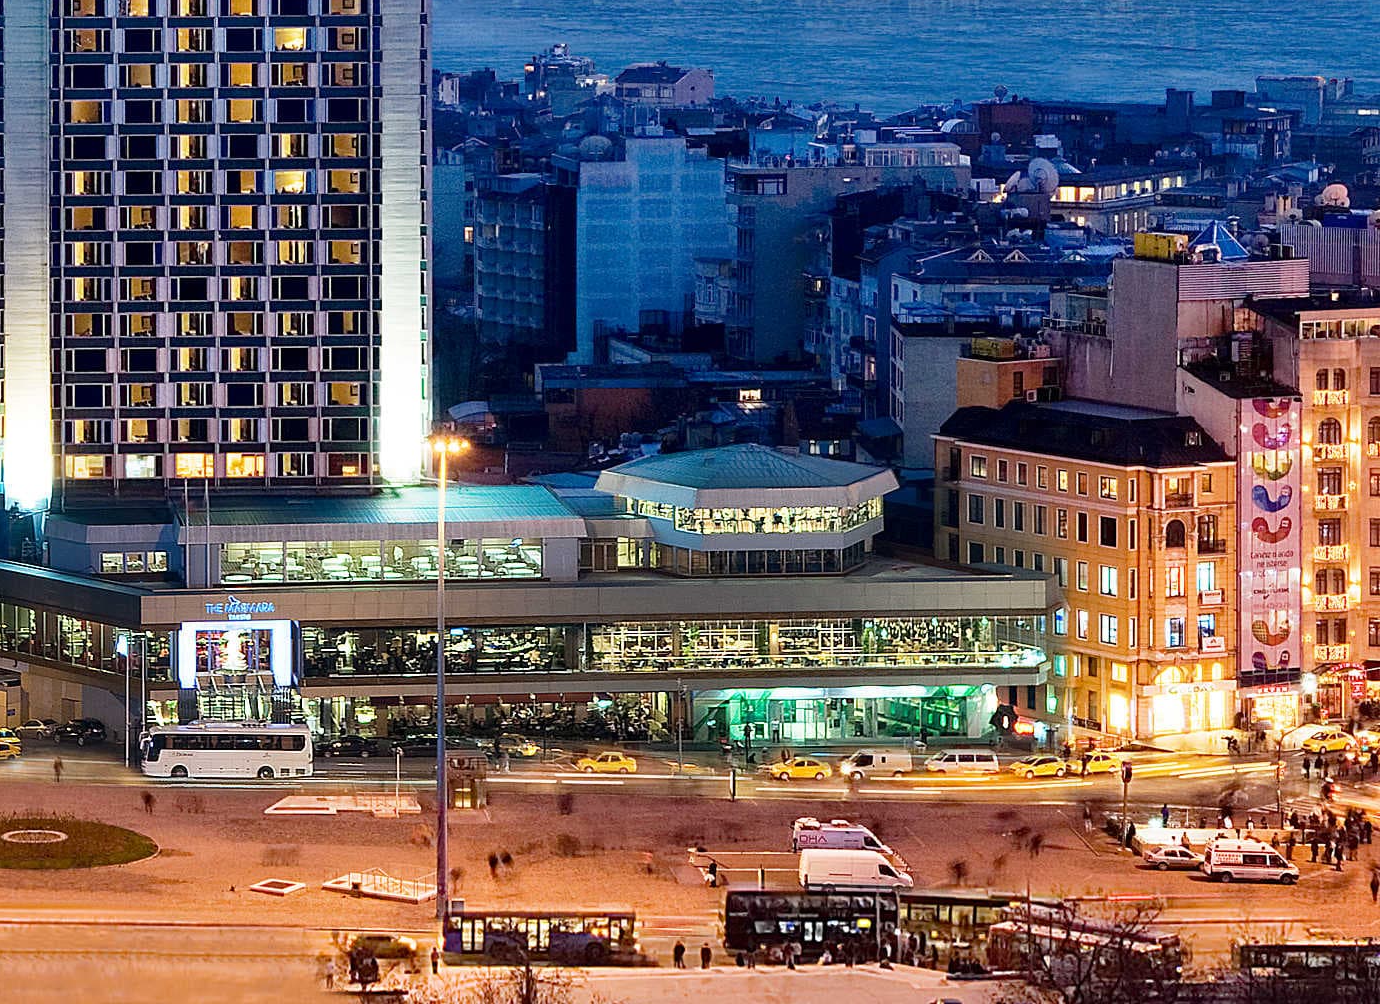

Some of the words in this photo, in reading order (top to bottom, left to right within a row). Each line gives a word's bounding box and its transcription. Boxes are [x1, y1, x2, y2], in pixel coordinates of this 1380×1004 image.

[205, 603, 223, 614] THE
[224, 602, 275, 613] MARMARA
[799, 835, 827, 843] DHA
